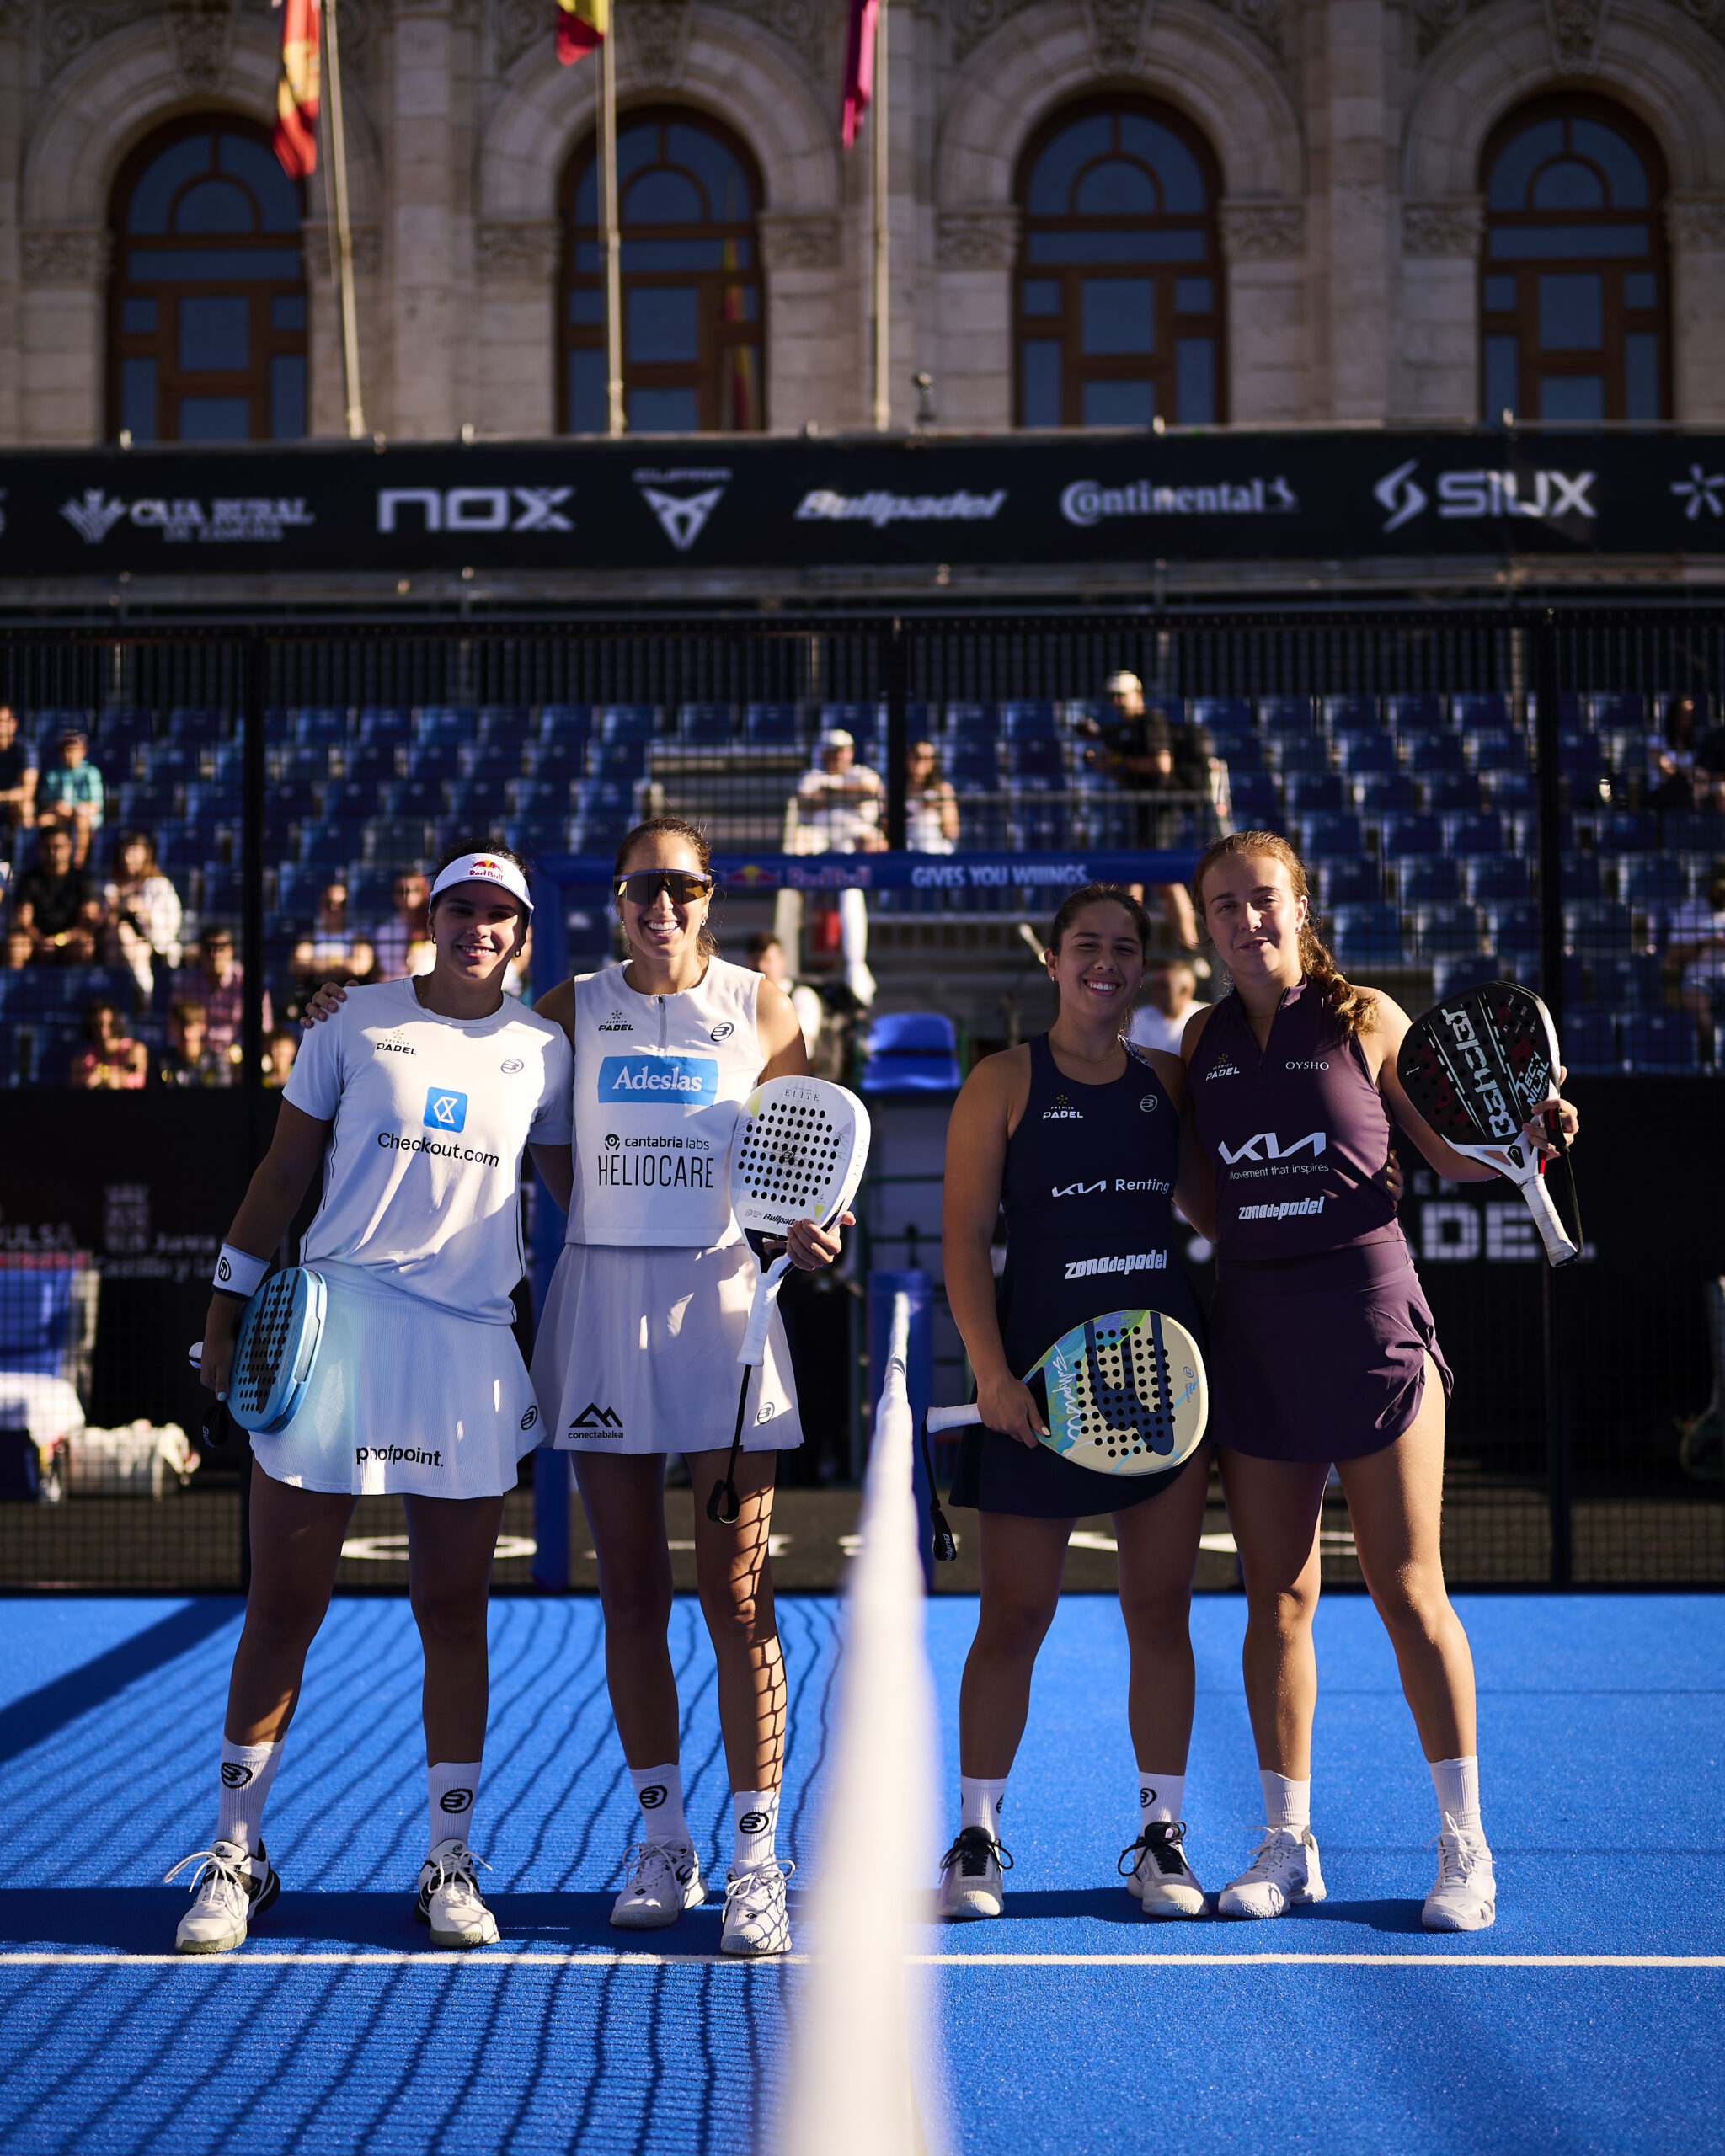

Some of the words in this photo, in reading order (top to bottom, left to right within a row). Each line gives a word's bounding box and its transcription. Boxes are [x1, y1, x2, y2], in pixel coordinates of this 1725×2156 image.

[1060, 479, 1264, 526] Continental
[488, 871, 503, 881] Bull
[912, 867, 964, 886] GIVES
[969, 867, 1007, 885] YOU
[376, 1043, 417, 1055] PADEL
[1285, 1061, 1330, 1070] OYSHO
[612, 1065, 702, 1092] Adeslas
[1205, 1067, 1241, 1081] PADEL
[784, 1089, 820, 1102] ELITE
[1043, 1110, 1084, 1120] PADEL
[377, 1132, 499, 1168] Checkout.com
[625, 1136, 683, 1149] cantabria
[686, 1137, 710, 1150] labs
[597, 1155, 714, 1188] HELIOCARE
[1270, 1161, 1290, 1175] that
[1292, 1163, 1329, 1174] inspires
[1115, 1179, 1170, 1194] Renting
[1238, 1196, 1325, 1221] zonadepadel
[763, 1213, 797, 1225] Bullpad
[1064, 1250, 1167, 1280] zonadepadel
